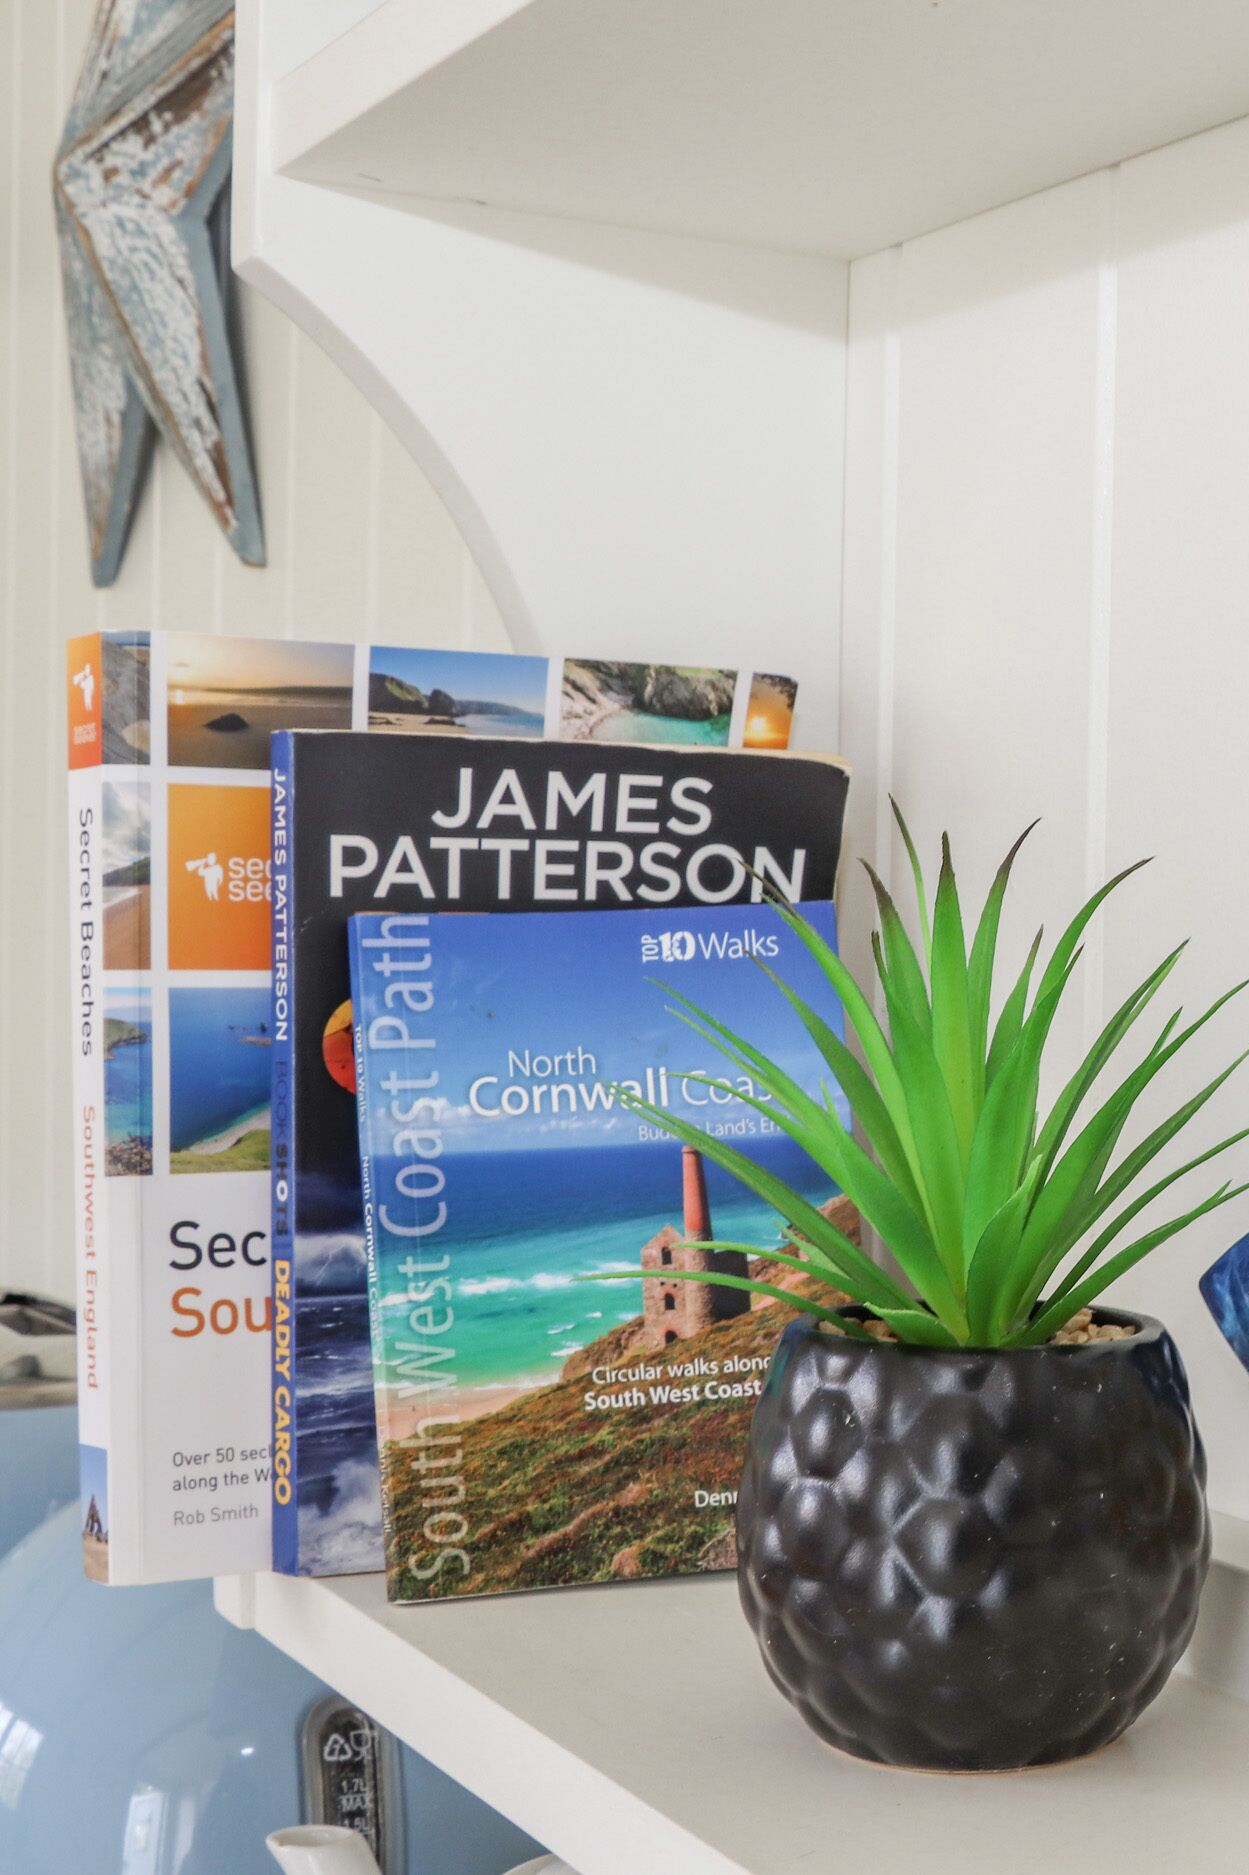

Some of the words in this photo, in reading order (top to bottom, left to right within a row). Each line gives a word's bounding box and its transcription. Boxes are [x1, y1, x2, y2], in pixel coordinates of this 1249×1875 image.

[273, 768, 287, 864] JAMES
[431, 767, 714, 836] JAMES
[79, 807, 94, 912] Secret
[328, 833, 807, 904] PATTERSON
[274, 874, 288, 1041] PATTERSON
[361, 915, 437, 1049] Path
[641, 934, 659, 964] TOP
[658, 930, 696, 963] 10
[698, 928, 779, 960] Walks
[80, 920, 93, 1057] Beaches
[468, 1066, 668, 1118] Cornwall
[507, 1046, 597, 1078] North
[379, 1070, 448, 1237] Coast
[638, 1123, 679, 1142] Bud
[705, 1117, 757, 1137] Land's
[760, 1115, 783, 1134] En
[83, 1104, 97, 1258] Southwest
[361, 1155, 372, 1200] North
[364, 1203, 378, 1284] Cornwall
[84, 1269, 98, 1389] England
[274, 1259, 291, 1382] DEADLY
[396, 1253, 458, 1399] West
[584, 1386, 647, 1411] South
[649, 1383, 701, 1405] West
[704, 1379, 763, 1401] Coast
[591, 1362, 664, 1386] Circular
[667, 1357, 719, 1378] walks
[172, 1451, 211, 1468] Over
[215, 1446, 236, 1464] 50
[172, 1475, 218, 1493] along
[224, 1470, 249, 1487] the
[274, 1386, 292, 1505] CARGO
[173, 1509, 206, 1527] Rob
[210, 1503, 259, 1523] Smith
[401, 1414, 471, 1581] South
